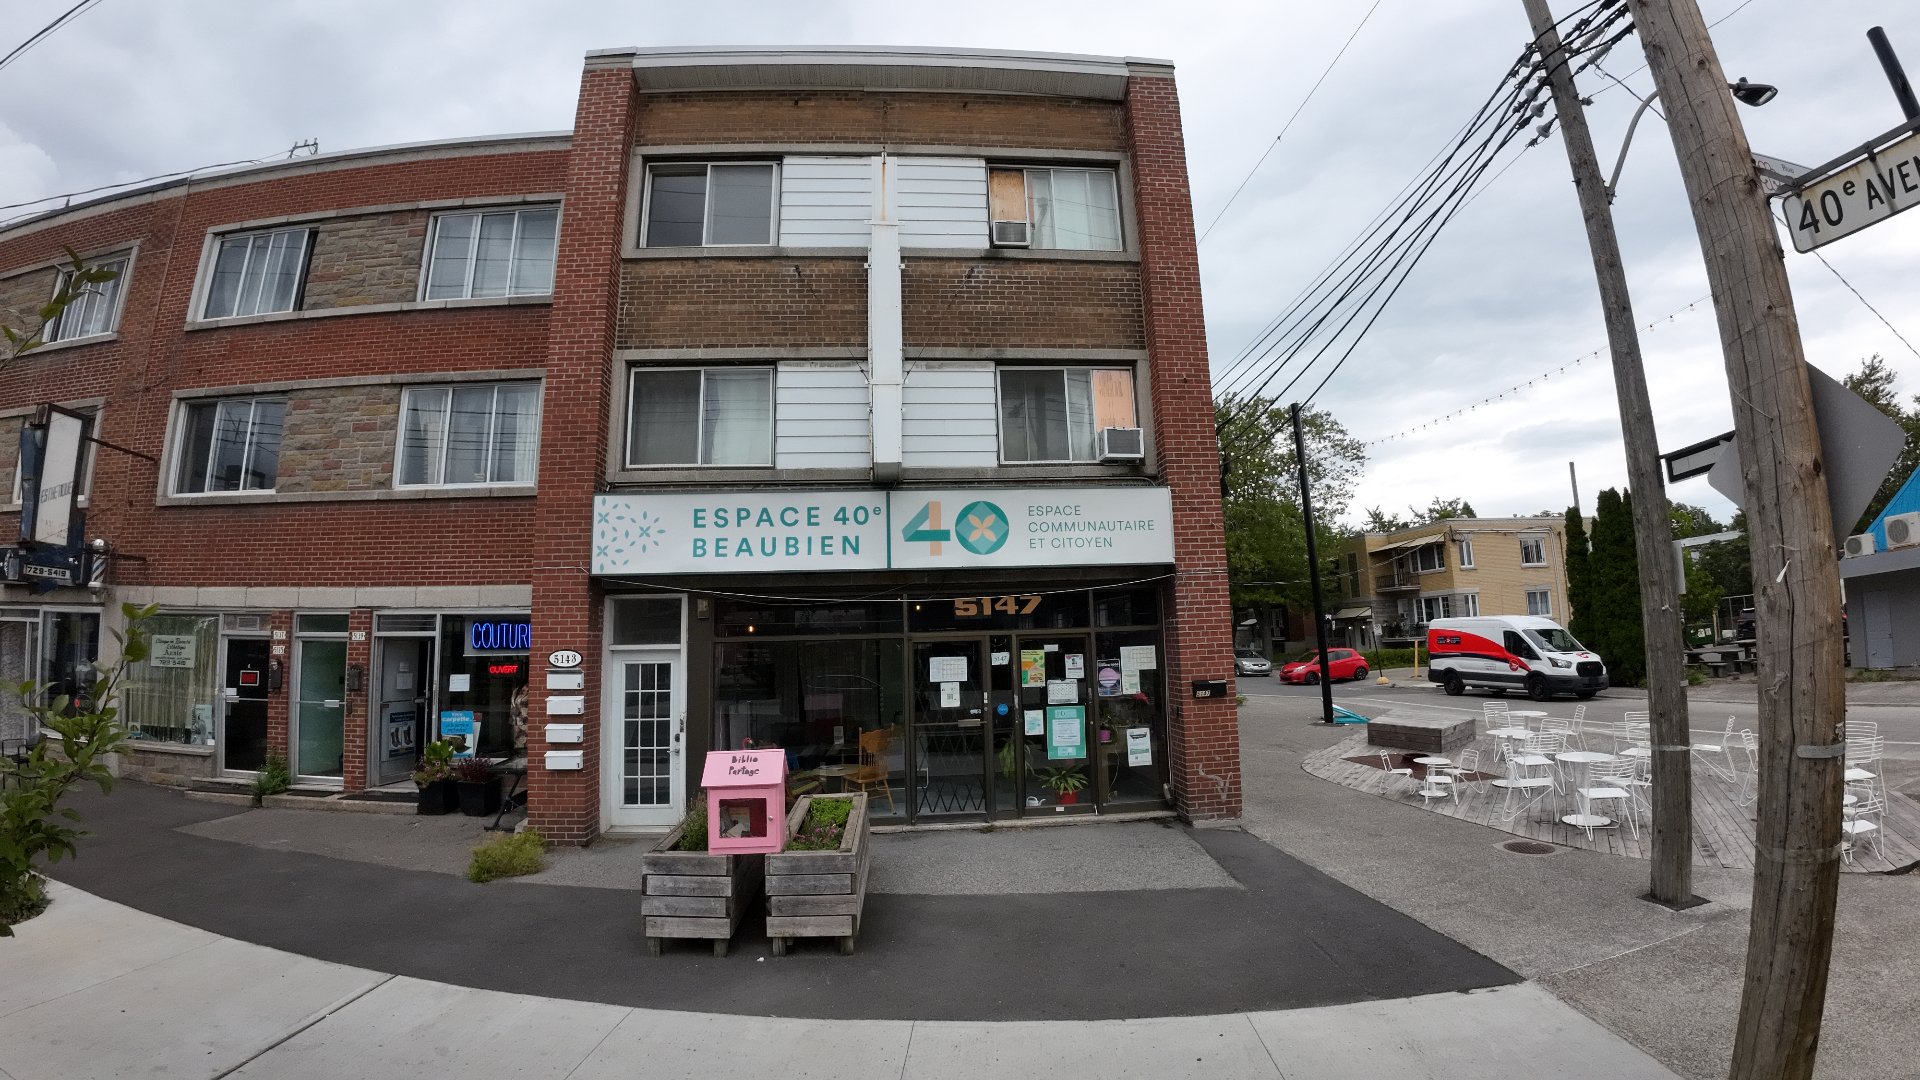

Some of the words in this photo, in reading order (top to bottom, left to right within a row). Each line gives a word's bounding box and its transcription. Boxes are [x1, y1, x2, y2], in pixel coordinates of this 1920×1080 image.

[1798, 180, 1856, 234] 40e
[693, 506, 821, 529] ESPACE
[833, 504, 882, 526] 40e
[1028, 505, 1082, 517] ESPACE
[1028, 519, 1155, 533] COMMUNAUTAIRE
[692, 535, 860, 558] BEAUBIEN
[1029, 538, 1046, 549] ET
[1051, 536, 1113, 549] CITOYEN
[954, 595, 1042, 617] 5147
[553, 653, 577, 664] 5143
[489, 664, 519, 674] OUVERT
[731, 755, 759, 764] Biblio
[728, 766, 760, 777] Partage
